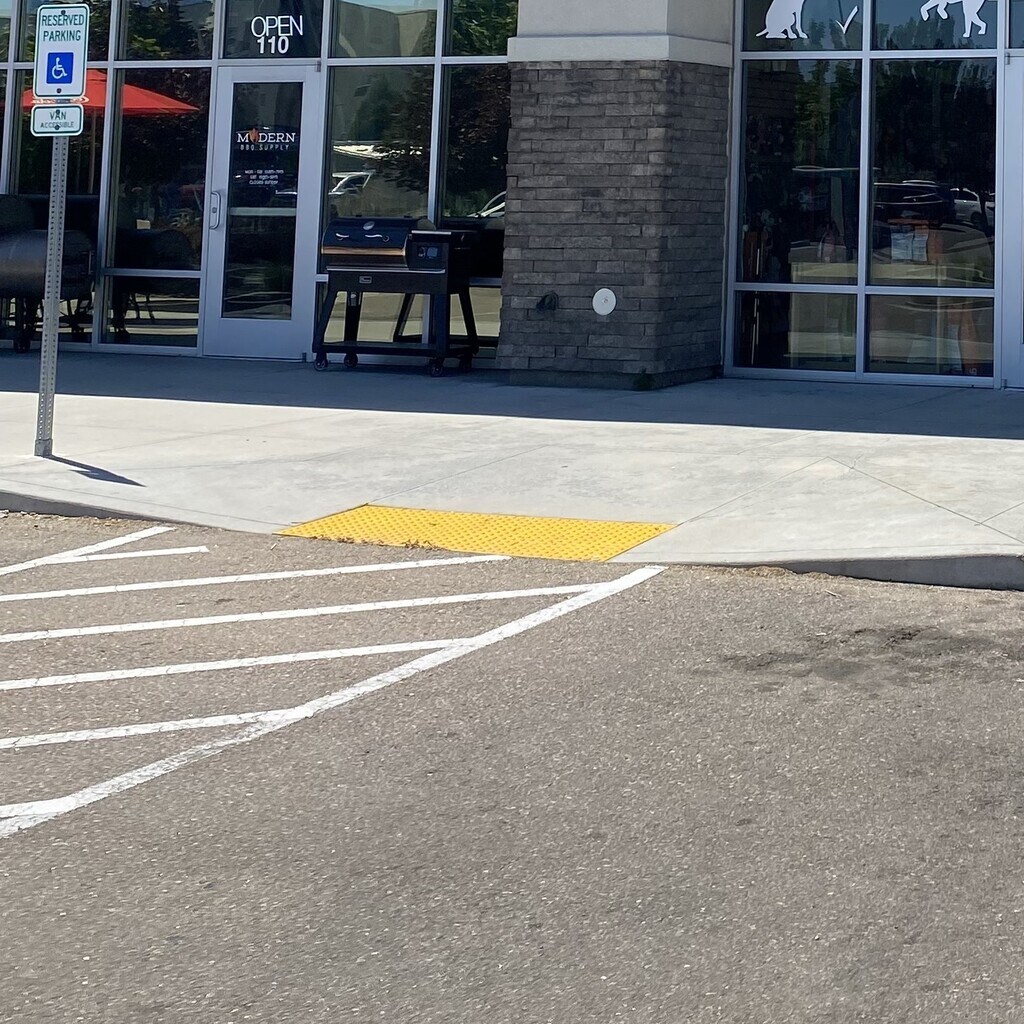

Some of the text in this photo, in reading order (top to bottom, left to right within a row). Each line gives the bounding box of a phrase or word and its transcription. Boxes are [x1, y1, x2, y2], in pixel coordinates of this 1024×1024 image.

[41, 14, 85, 27] RESERVED
[251, 15, 303, 38] OPEN
[42, 29, 82, 42] PARKING
[257, 36, 290, 55] 110
[49, 111, 67, 120] VAN
